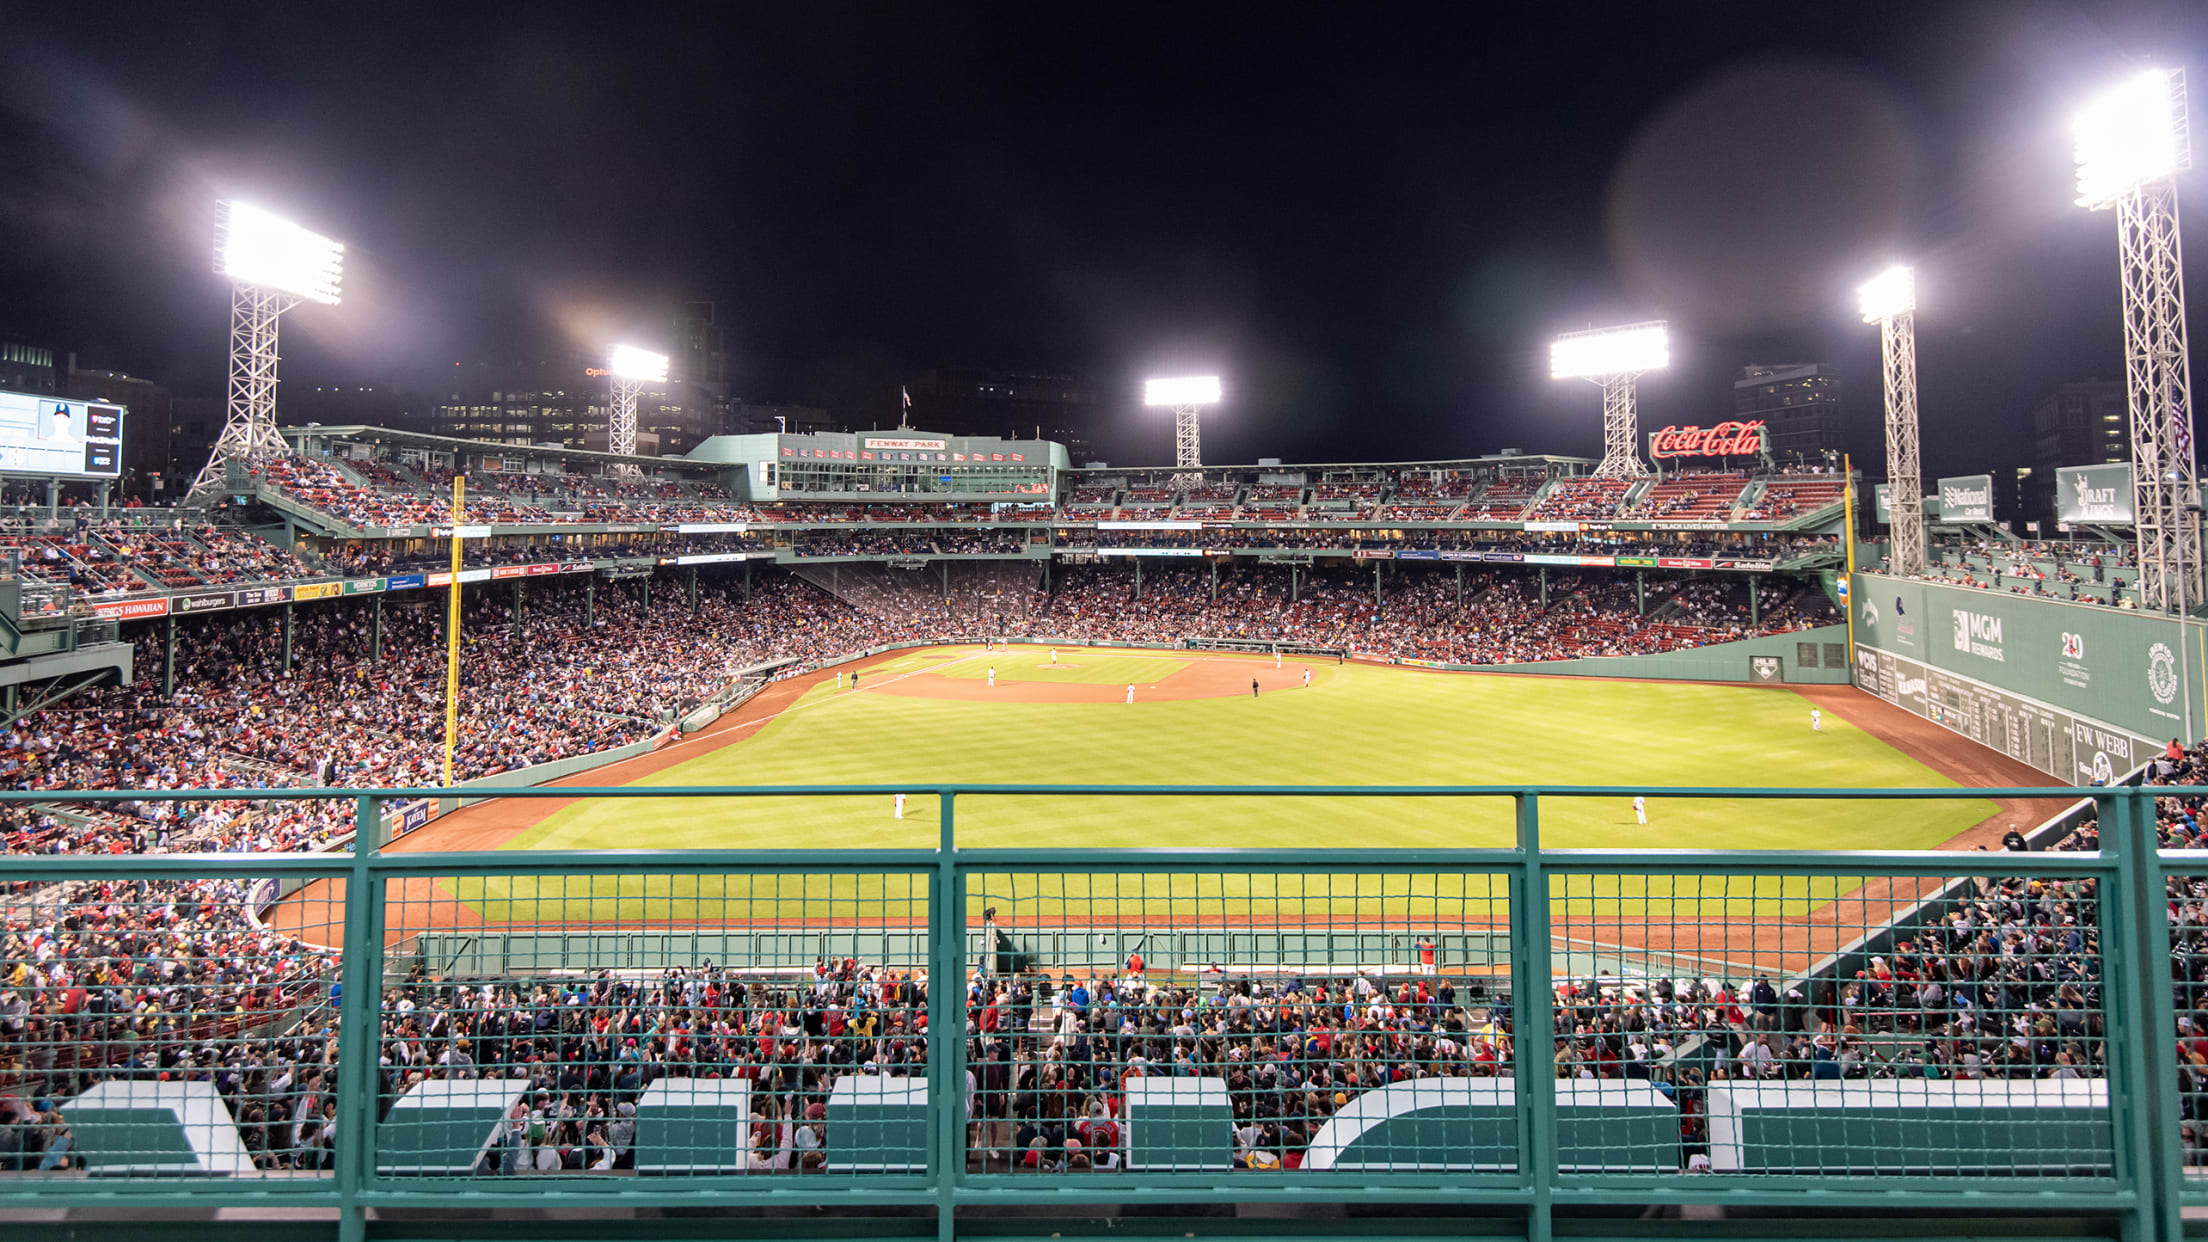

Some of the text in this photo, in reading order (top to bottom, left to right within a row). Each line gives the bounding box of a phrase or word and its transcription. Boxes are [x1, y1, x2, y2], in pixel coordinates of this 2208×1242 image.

[1651, 419, 1764, 459] Coca-Cola
[1954, 486, 1987, 505] National
[2078, 488, 2115, 506] DRAFT
[1734, 561, 1771, 570] Safelite
[1969, 612, 2003, 644] MGM
[2094, 730, 2129, 759] WEBB
